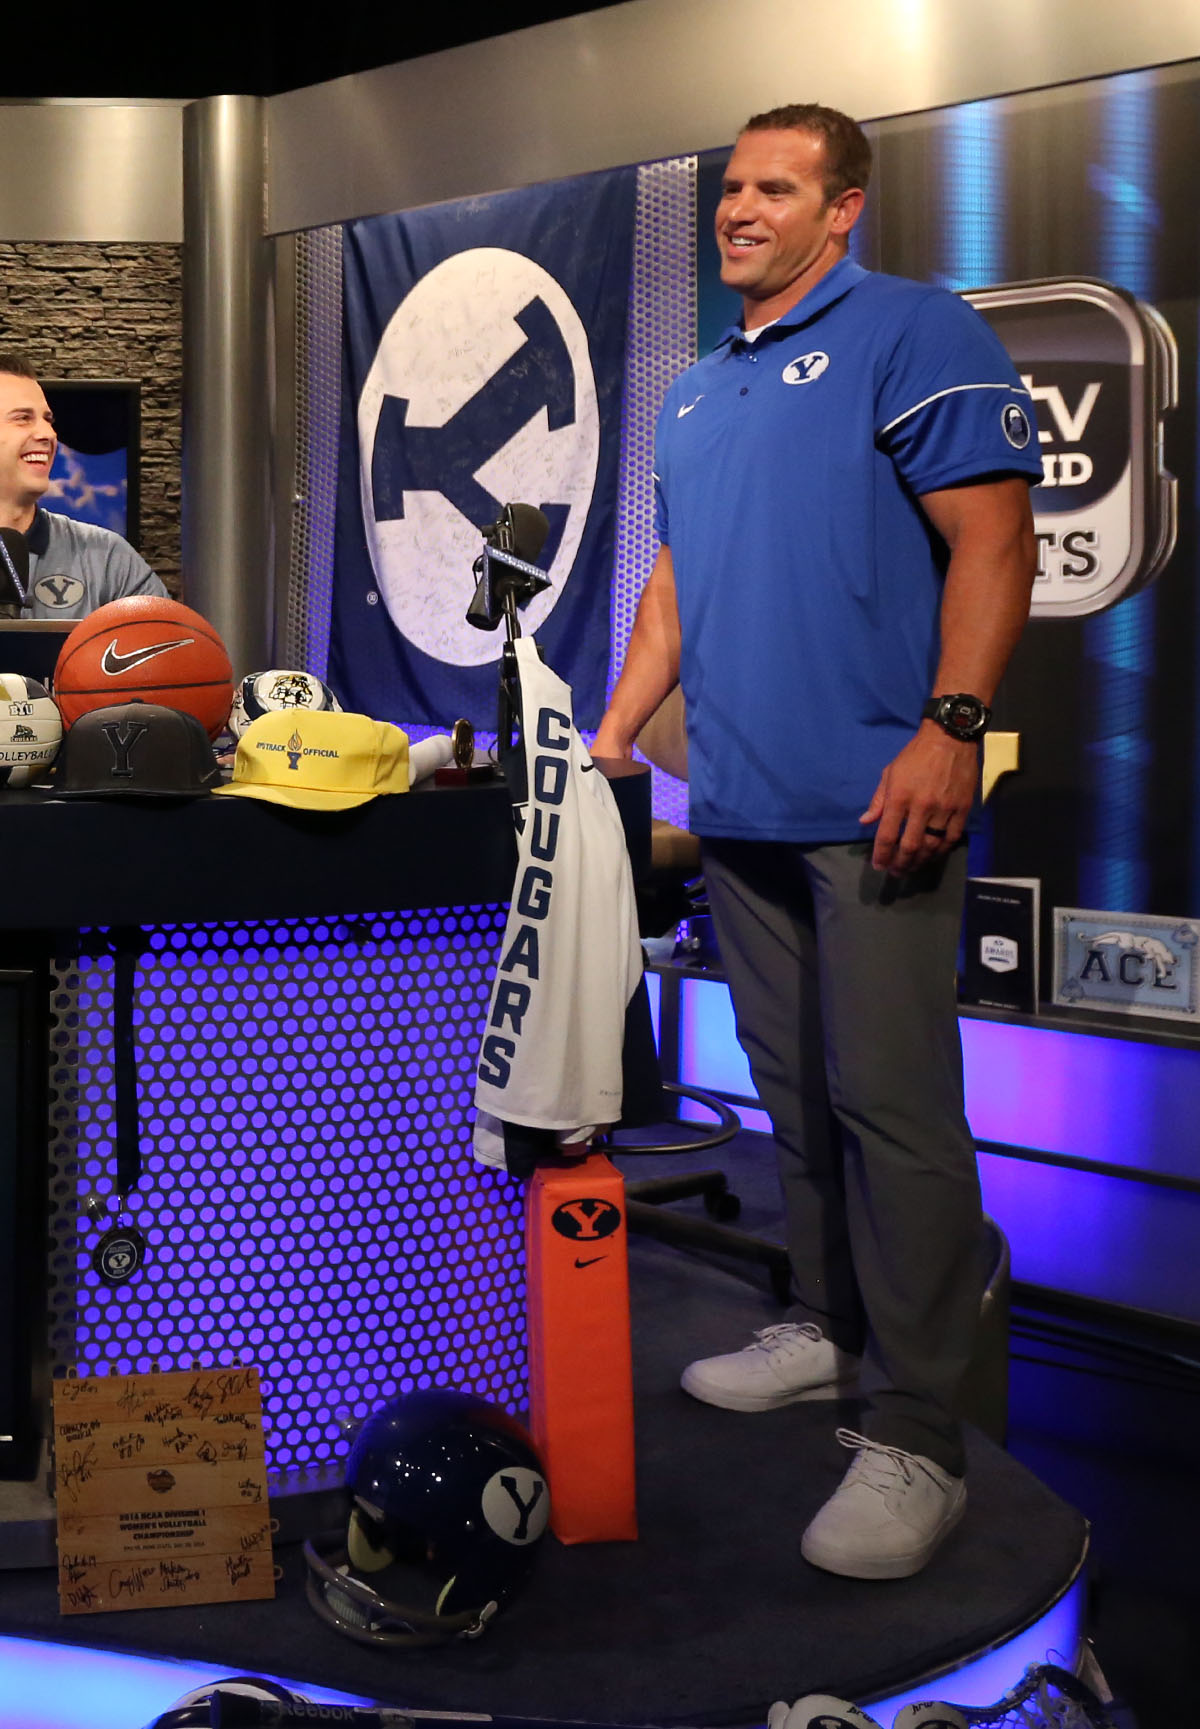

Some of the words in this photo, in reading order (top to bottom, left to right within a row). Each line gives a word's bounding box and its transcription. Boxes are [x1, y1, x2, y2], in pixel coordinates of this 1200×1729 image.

[9, 701, 34, 716] BYU
[101, 721, 148, 778] Y
[266, 743, 287, 752] TRACK
[303, 748, 339, 758] OFFICIAL
[478, 707, 571, 1089] COUGARS
[1080, 949, 1178, 989] ACE
[141, 1511, 163, 1520] NCAA
[164, 1509, 200, 1519] DIVISION
[119, 1521, 157, 1531] WOMEN'S
[158, 1519, 207, 1529] VOLLEYBALL
[133, 1530, 194, 1540] CHAMPIONSHIP
